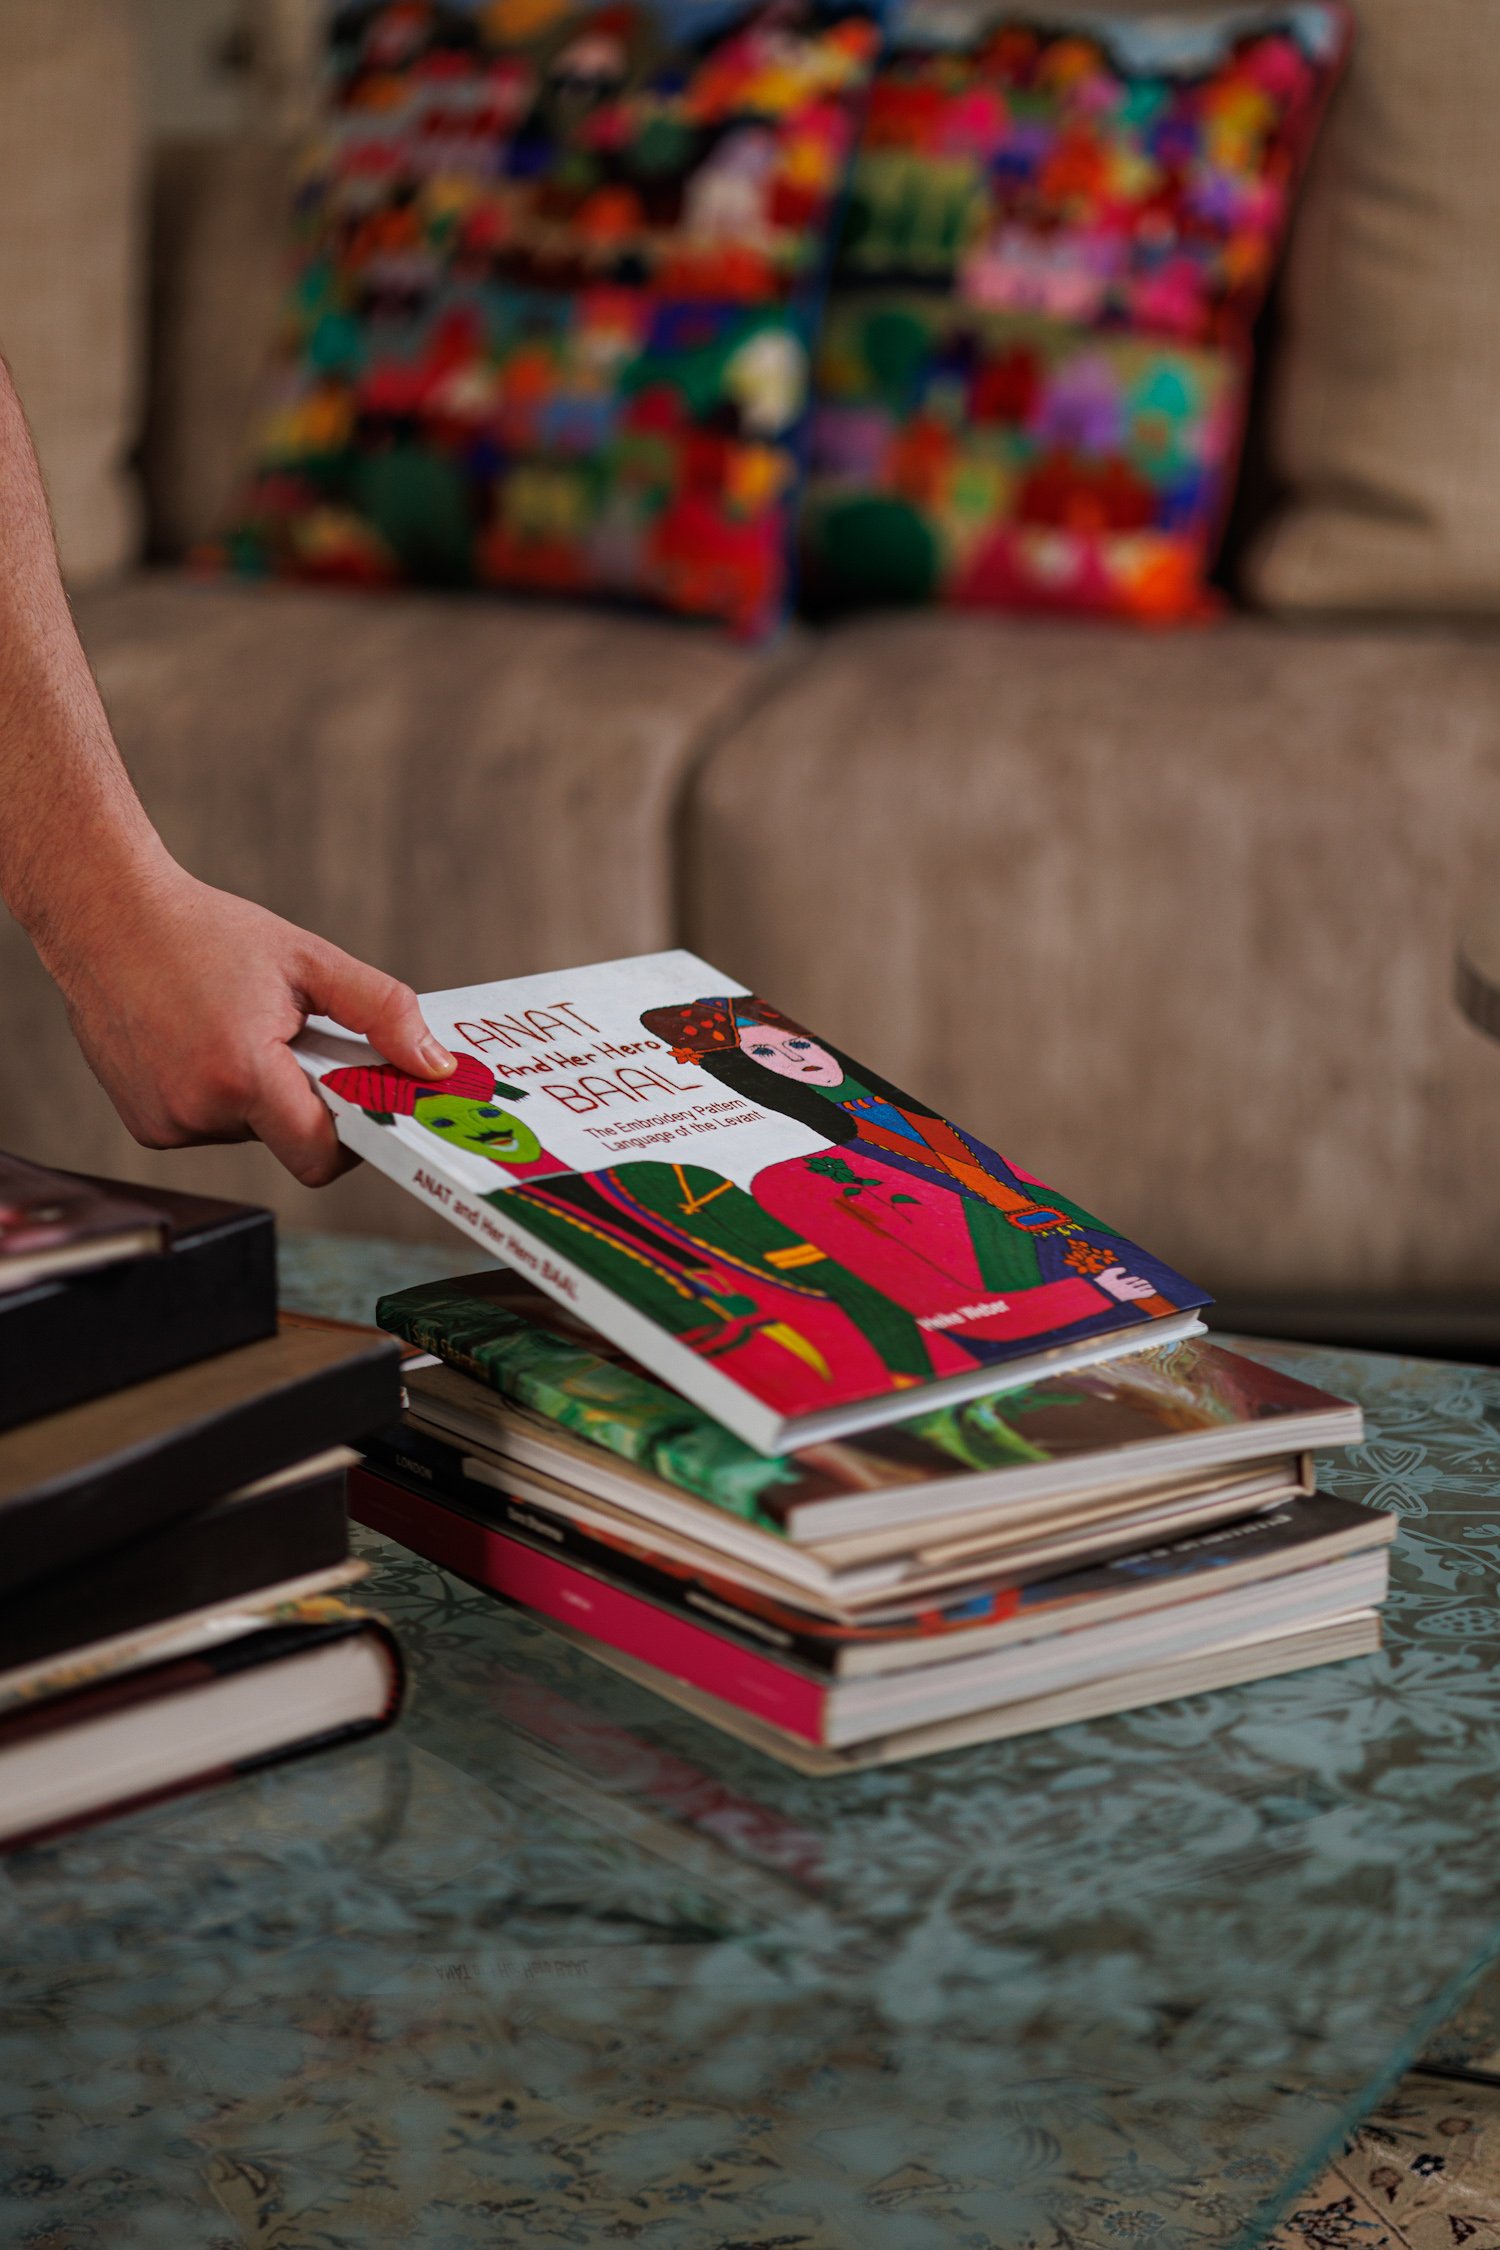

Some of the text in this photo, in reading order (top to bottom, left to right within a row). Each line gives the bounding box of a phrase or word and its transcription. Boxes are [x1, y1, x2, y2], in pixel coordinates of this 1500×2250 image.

[454, 1002, 600, 1053] ANAT
[496, 1040, 661, 1078] And Her Hero
[541, 1065, 704, 1114] BAAL
[582, 1099, 748, 1139] The Embroidery Pattern
[602, 1110, 767, 1152] Language of the Levant
[413, 1168, 579, 1301] ANAT and Her Hero BAAL
[395, 1454, 433, 1481] LONDON
